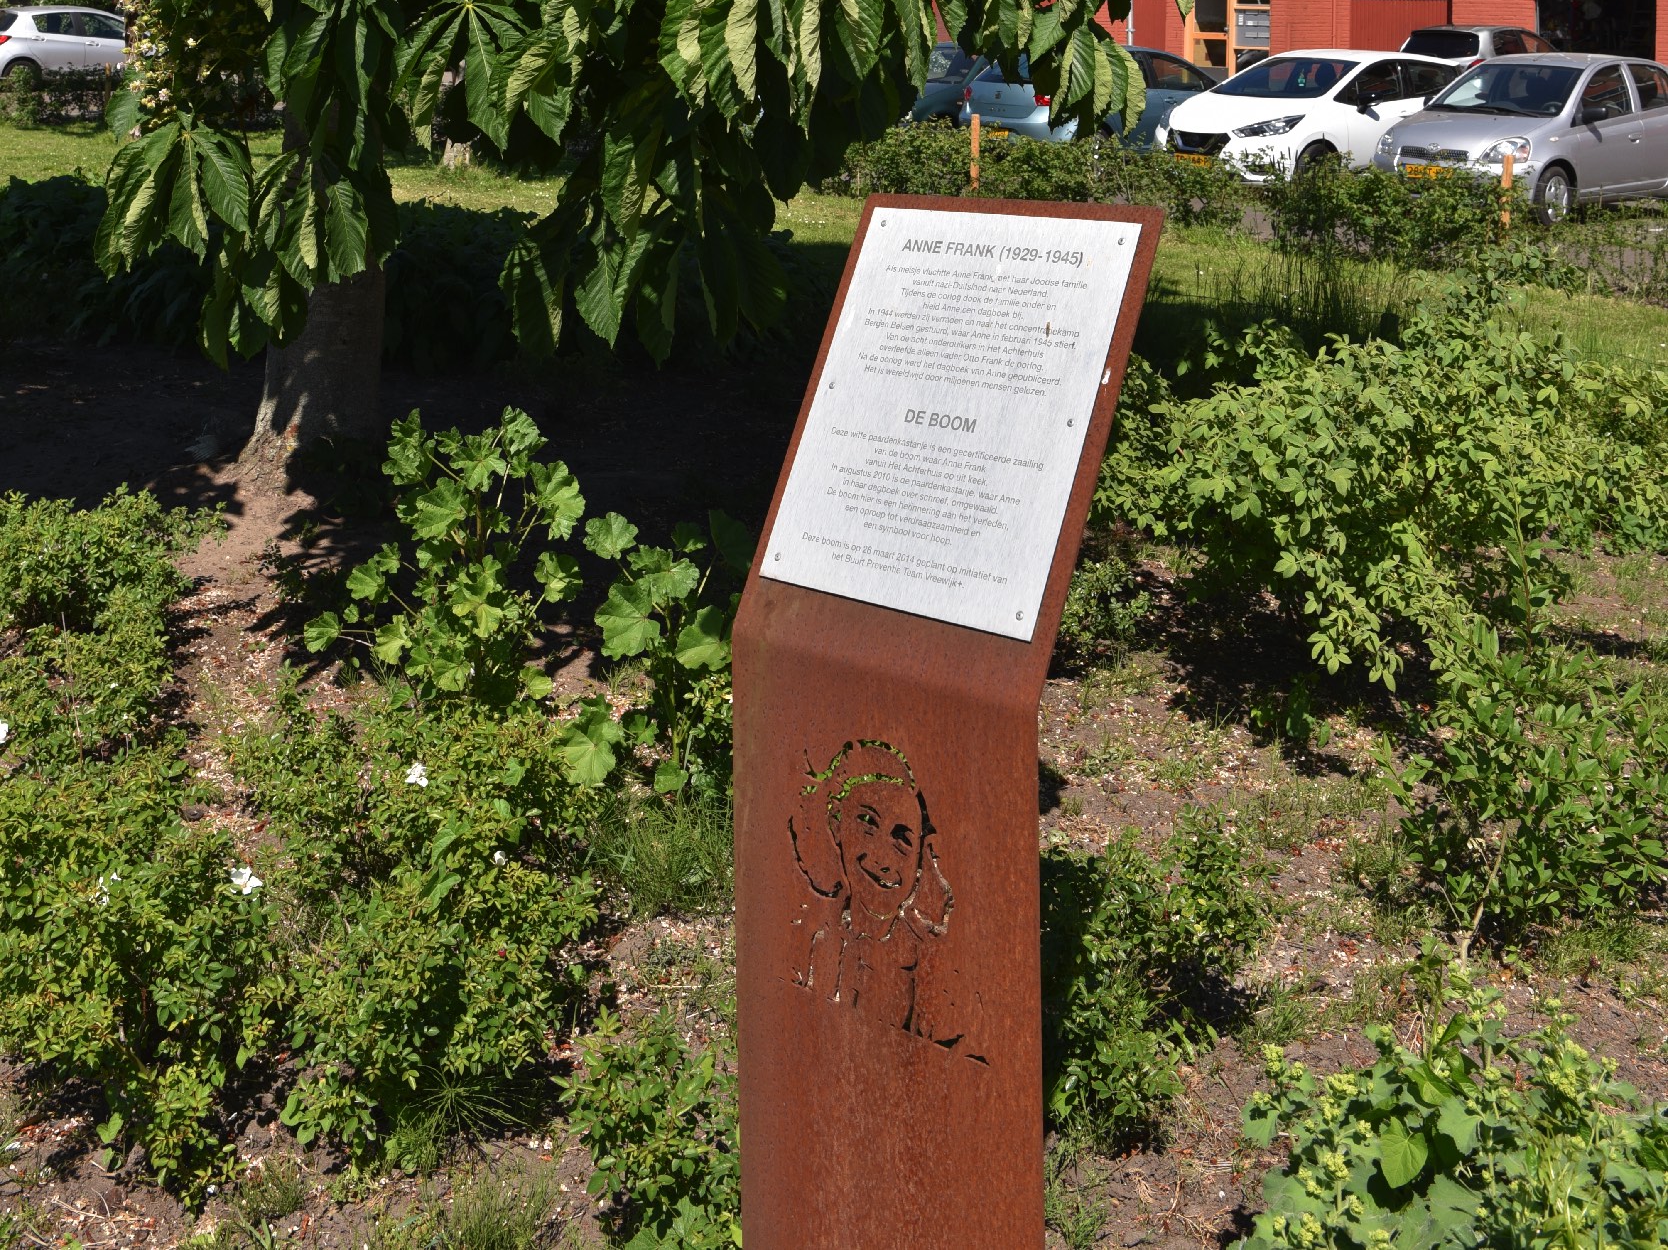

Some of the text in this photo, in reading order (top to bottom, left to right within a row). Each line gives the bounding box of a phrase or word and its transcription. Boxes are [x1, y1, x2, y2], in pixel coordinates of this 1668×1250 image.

[902, 238, 1085, 267] ANNE FRANK (1929-1945)
[898, 266, 921, 275] meisje
[922, 267, 950, 276] vluchtte
[952, 270, 971, 278] Anne
[1011, 275, 1029, 283] haar
[1030, 277, 1059, 286] Joodse
[1061, 279, 1088, 289] familie
[900, 288, 925, 297] Tijdens
[926, 290, 936, 298] de
[937, 293, 961, 302] oorlog
[962, 294, 982, 303] dook
[983, 296, 993, 304] de
[994, 297, 1020, 307] familie
[1021, 301, 1044, 309] onder
[922, 301, 941, 310] hield
[941, 303, 960, 312] Anne
[977, 307, 1011, 317] dagboek
[864, 318, 889, 328] Bergen
[890, 321, 914, 330] Belsen
[951, 329, 969, 337] waar
[971, 330, 990, 339] Anne
[992, 332, 999, 340] in
[1001, 333, 1032, 344] februari
[1033, 337, 1053, 346] 1945
[876, 308, 893, 316] 1944
[894, 311, 920, 319] werden
[921, 313, 930, 322] zij
[994, 321, 1007, 329] het
[1008, 324, 1080, 339] concentraiekamp
[879, 344, 915, 354] overleefde
[917, 348, 938, 357] alleen
[940, 351, 961, 360] vader
[963, 353, 979, 362] Otto
[981, 355, 1003, 365] Frank
[1004, 358, 1014, 367] de
[886, 332, 899, 340] Van
[978, 343, 985, 351] in
[986, 344, 1001, 353] Het
[1002, 346, 1044, 358] Achterhuis
[857, 352, 868, 360] Na
[869, 353, 878, 361] de
[879, 356, 902, 366] oorlog
[904, 359, 922, 367] werd
[923, 360, 935, 369] het
[936, 362, 970, 373] dagboek
[986, 368, 1006, 378] Anne
[864, 364, 877, 373] Het
[877, 366, 884, 374] is
[925, 372, 942, 382] door
[981, 382, 1012, 391] mensen
[903, 408, 978, 433] DE BOOM
[831, 427, 1044, 471] Deze witte paardenkastanje is een gecertificeerde zaailing
[888, 448, 898, 457] de
[899, 450, 921, 461] boom
[922, 456, 941, 465] waar
[942, 458, 962, 468] Anne
[964, 461, 987, 473] Frank
[865, 459, 887, 468] vanuit
[888, 461, 902, 470] Het
[902, 463, 942, 478] Achterhuis
[943, 473, 955, 482] op
[956, 474, 966, 482] uit
[830, 463, 837, 471] In
[839, 466, 871, 478] augustus
[873, 471, 891, 481] 2010
[891, 474, 898, 483] is
[899, 476, 910, 485] de
[977, 492, 997, 501] waar
[999, 494, 1021, 505] Anne
[842, 478, 849, 486] in
[850, 479, 866, 489] haar
[867, 482, 900, 495] dagboek
[901, 491, 918, 499] over
[826, 487, 837, 496] De
[838, 489, 859, 500] boom
[860, 493, 874, 503] hier
[875, 496, 882, 505] is
[883, 500, 897, 508] een
[942, 511, 957, 519] aan
[958, 512, 972, 522] het
[844, 505, 858, 513] een
[859, 508, 885, 520] oproep
[887, 511, 898, 521] tot
[970, 530, 981, 538] en
[863, 521, 877, 530] een
[878, 525, 911, 537] symbool
[911, 531, 929, 540] voor
[802, 532, 820, 543] Deze
[821, 536, 842, 548] boom
[843, 541, 849, 549] is
[851, 544, 861, 554] op
[873, 549, 895, 559] maart
[896, 552, 915, 564] 2014
[915, 559, 946, 570] geplant
[946, 565, 958, 575] op
[959, 566, 991, 580] initiatief
[992, 575, 1008, 584] van
[831, 551, 844, 561] het
[844, 554, 865, 566] Buurt
[866, 559, 901, 574] Preventie
[902, 567, 923, 579] Team
